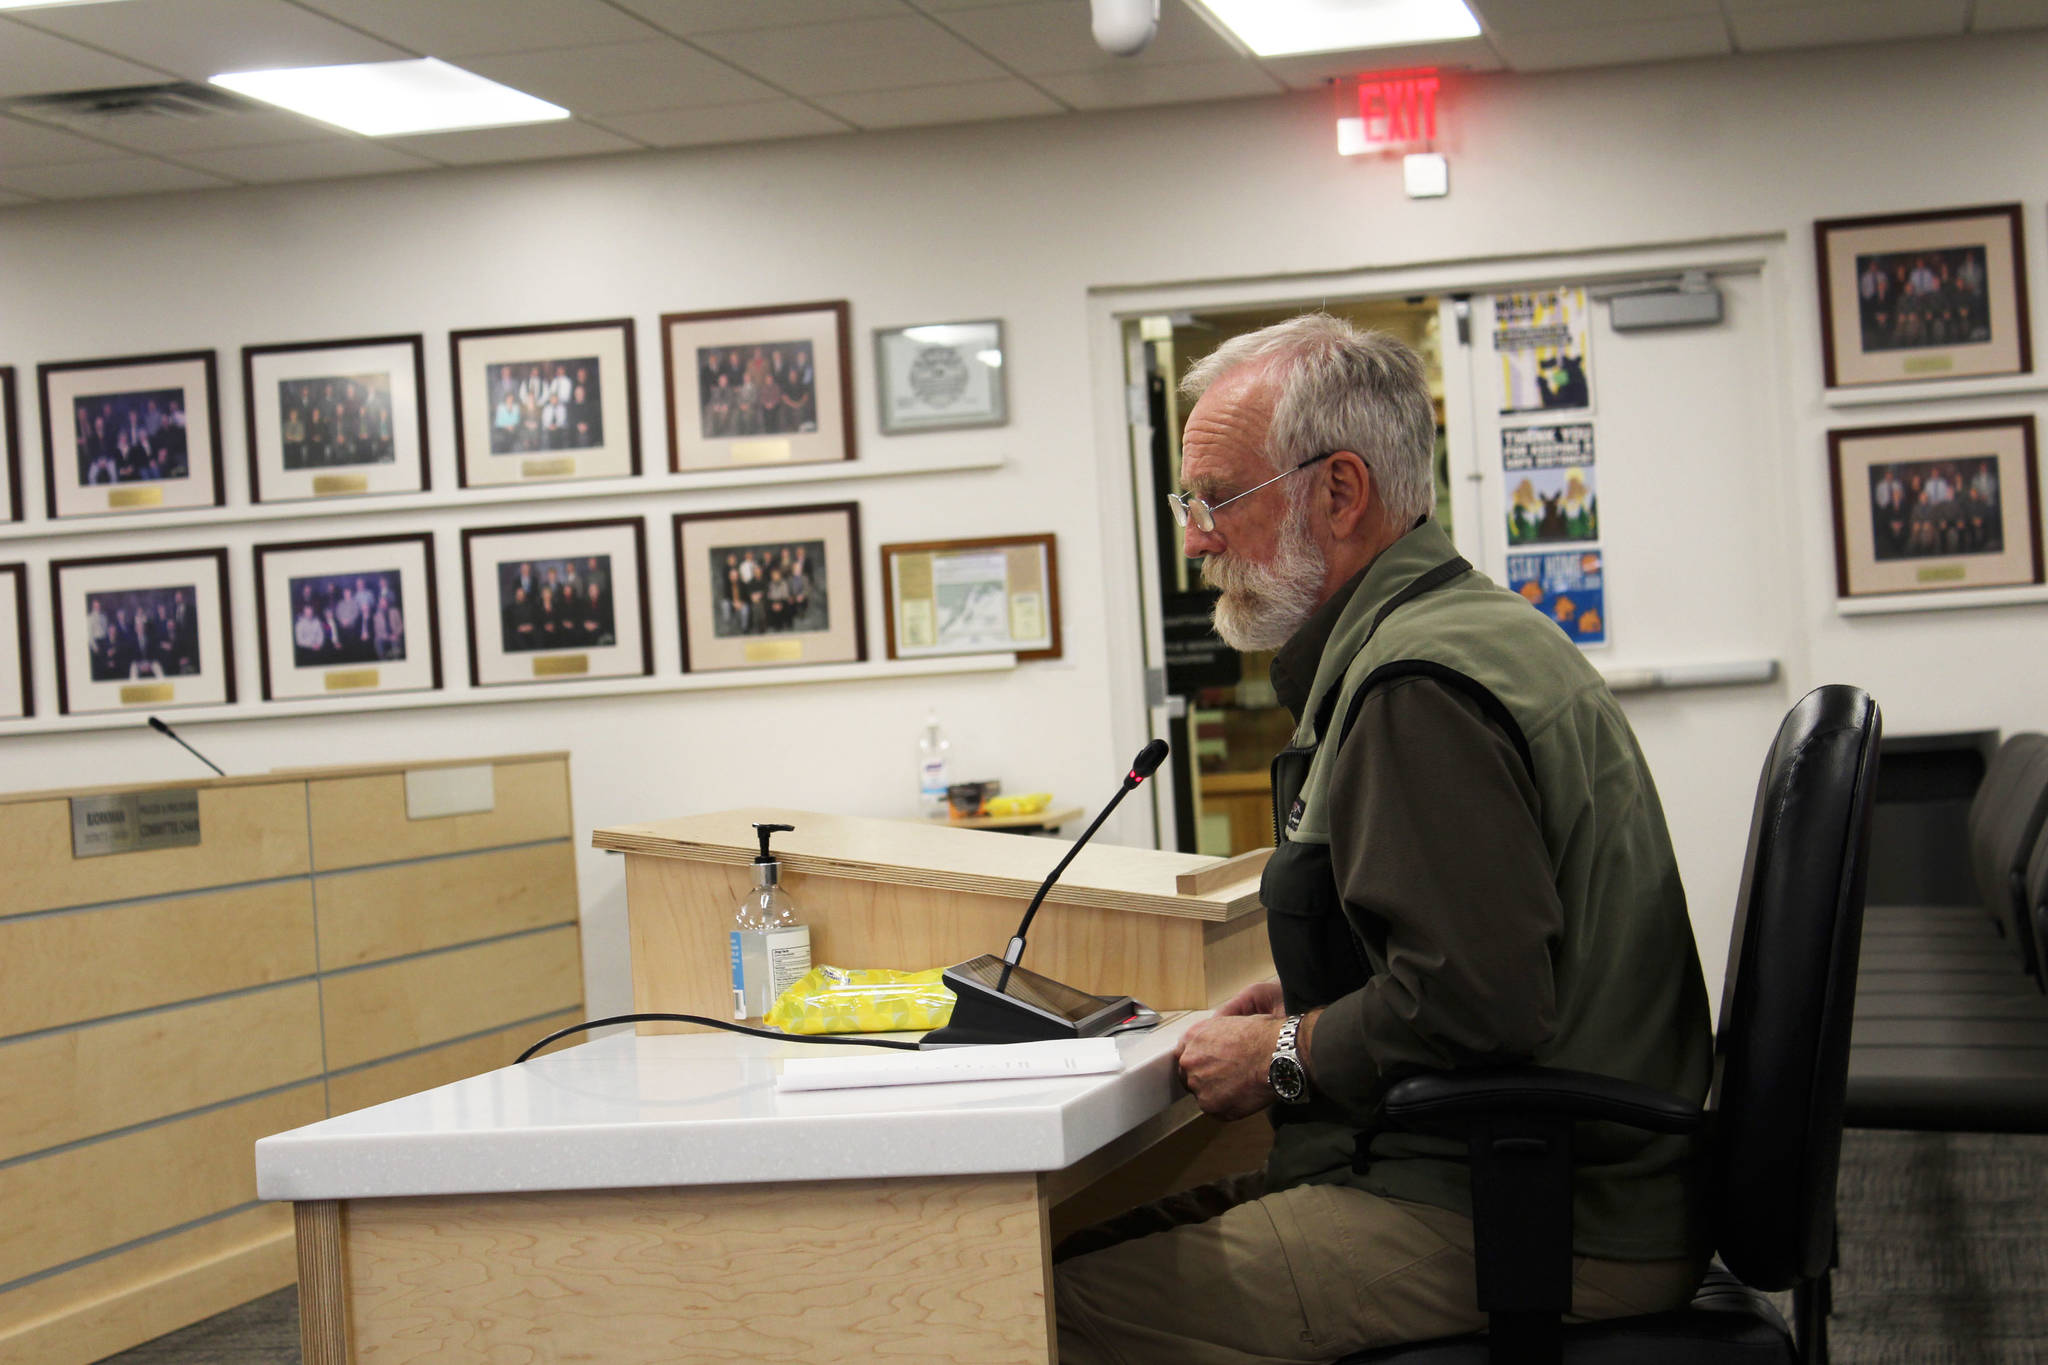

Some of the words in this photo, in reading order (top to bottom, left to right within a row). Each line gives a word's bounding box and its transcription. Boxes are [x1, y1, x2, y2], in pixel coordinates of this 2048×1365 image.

[1359, 78, 1439, 142] EXIT
[1504, 429, 1555, 446] THANK
[1558, 426, 1592, 442] YOU
[1511, 556, 1541, 583] STAY
[1544, 553, 1581, 580] HOME
